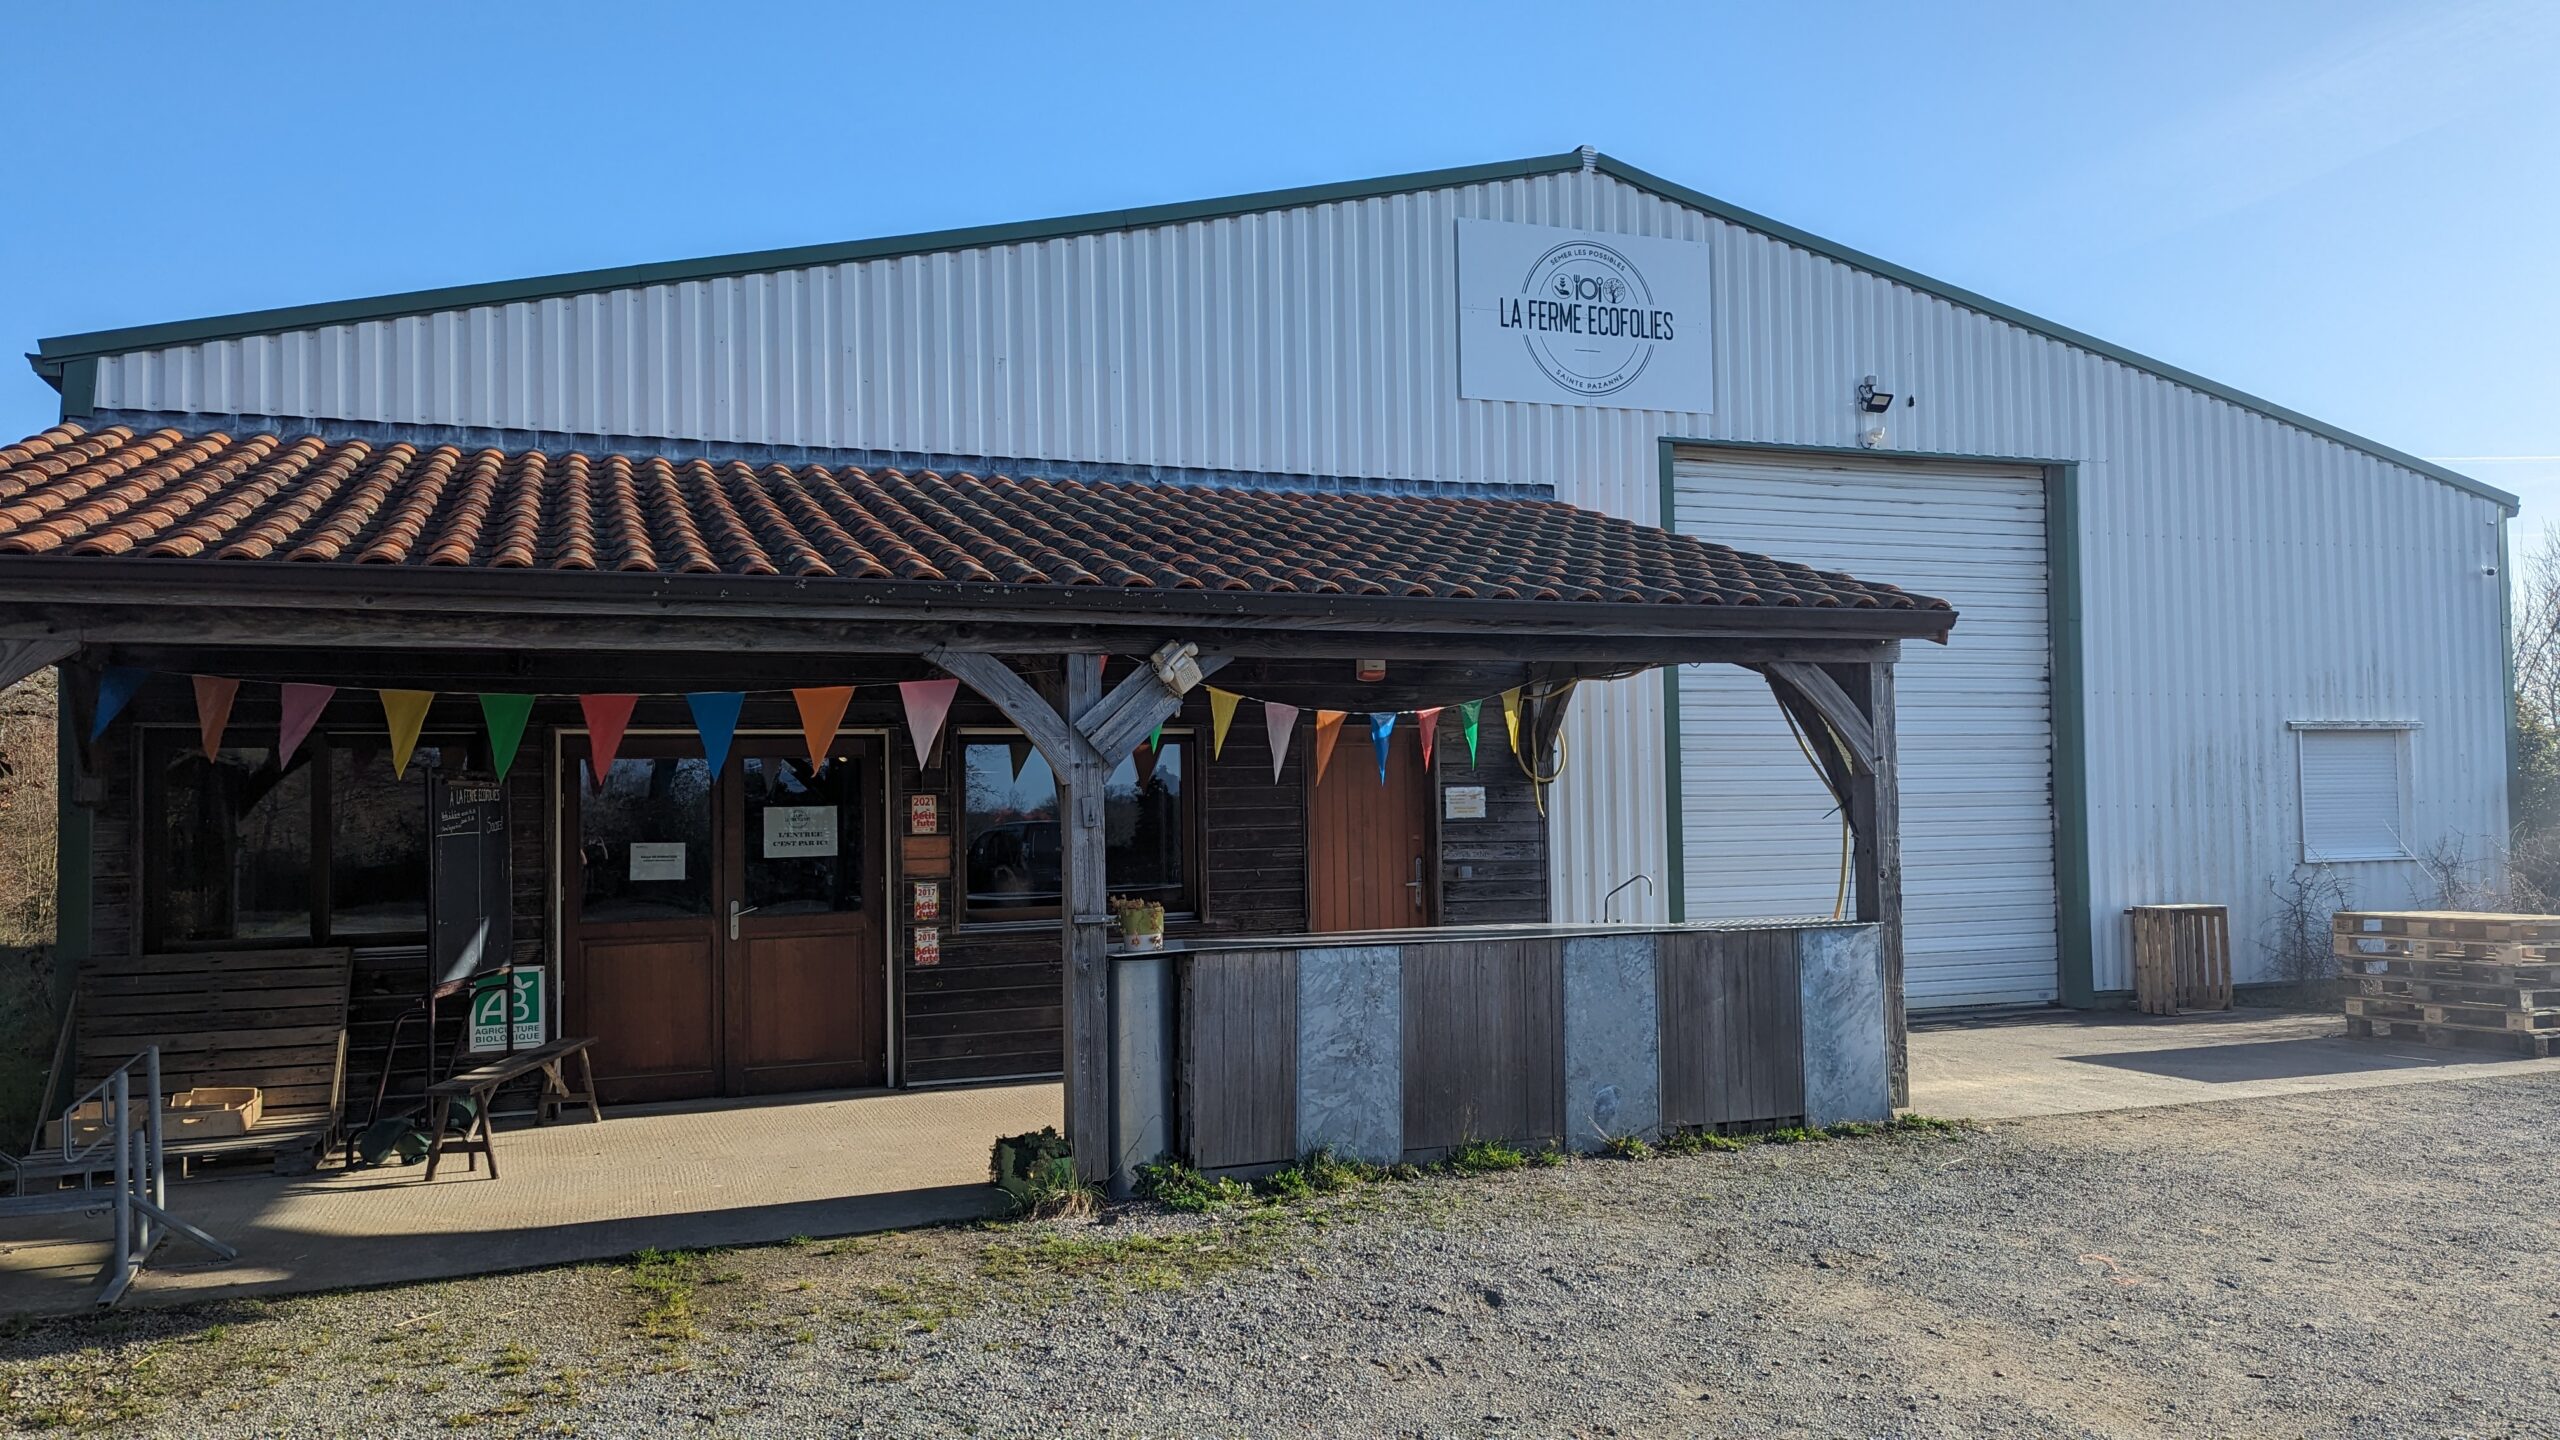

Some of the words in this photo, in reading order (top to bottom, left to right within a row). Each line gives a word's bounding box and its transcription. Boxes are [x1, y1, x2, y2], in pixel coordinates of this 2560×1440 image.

[1550, 250, 1573, 266] SEMER
[1573, 249, 1588, 257] LES
[1588, 249, 1627, 272] POSSIBLES
[1499, 297, 1523, 329] LA
[1528, 299, 1583, 334] FERME
[1588, 304, 1675, 341] ECOFOLIES
[1555, 368, 1584, 389] SAINTE
[1587, 373, 1625, 390] PAZANNE
[456, 789, 464, 805] LA
[913, 797, 935, 806] 2021
[912, 811, 936, 821] petit
[918, 888, 936, 896] 2017
[918, 933, 936, 941] 2018
[480, 988, 530, 1024] AB
[475, 1025, 540, 1036] AGRICTURE
[475, 1033, 540, 1043] BIOLOIQUE
